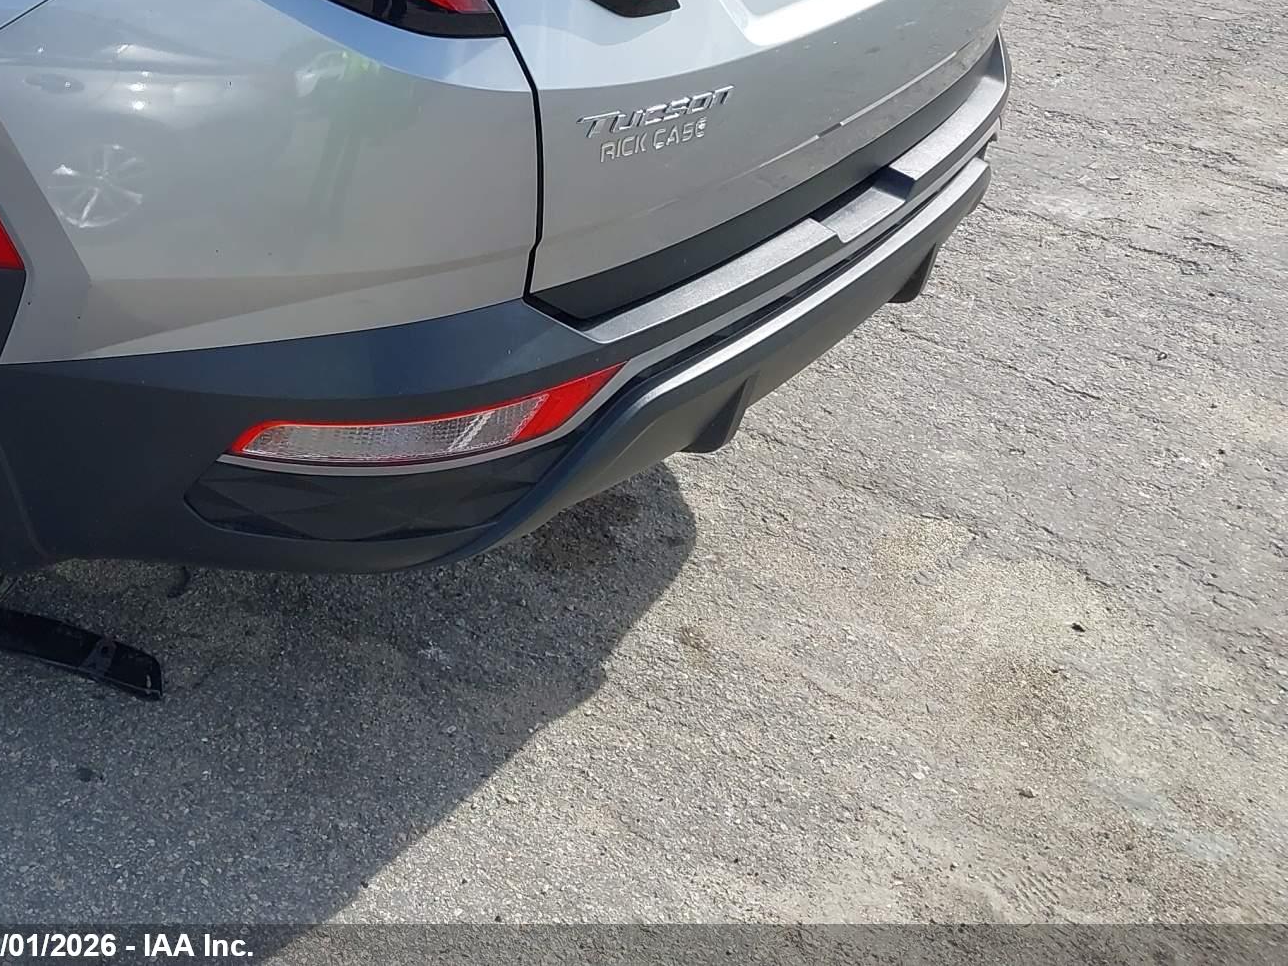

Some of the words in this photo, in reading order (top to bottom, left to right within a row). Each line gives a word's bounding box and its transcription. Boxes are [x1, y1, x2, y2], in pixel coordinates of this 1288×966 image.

[576, 84, 734, 139] TUCSON
[600, 132, 647, 163] RICK
[653, 116, 707, 150] CASE
